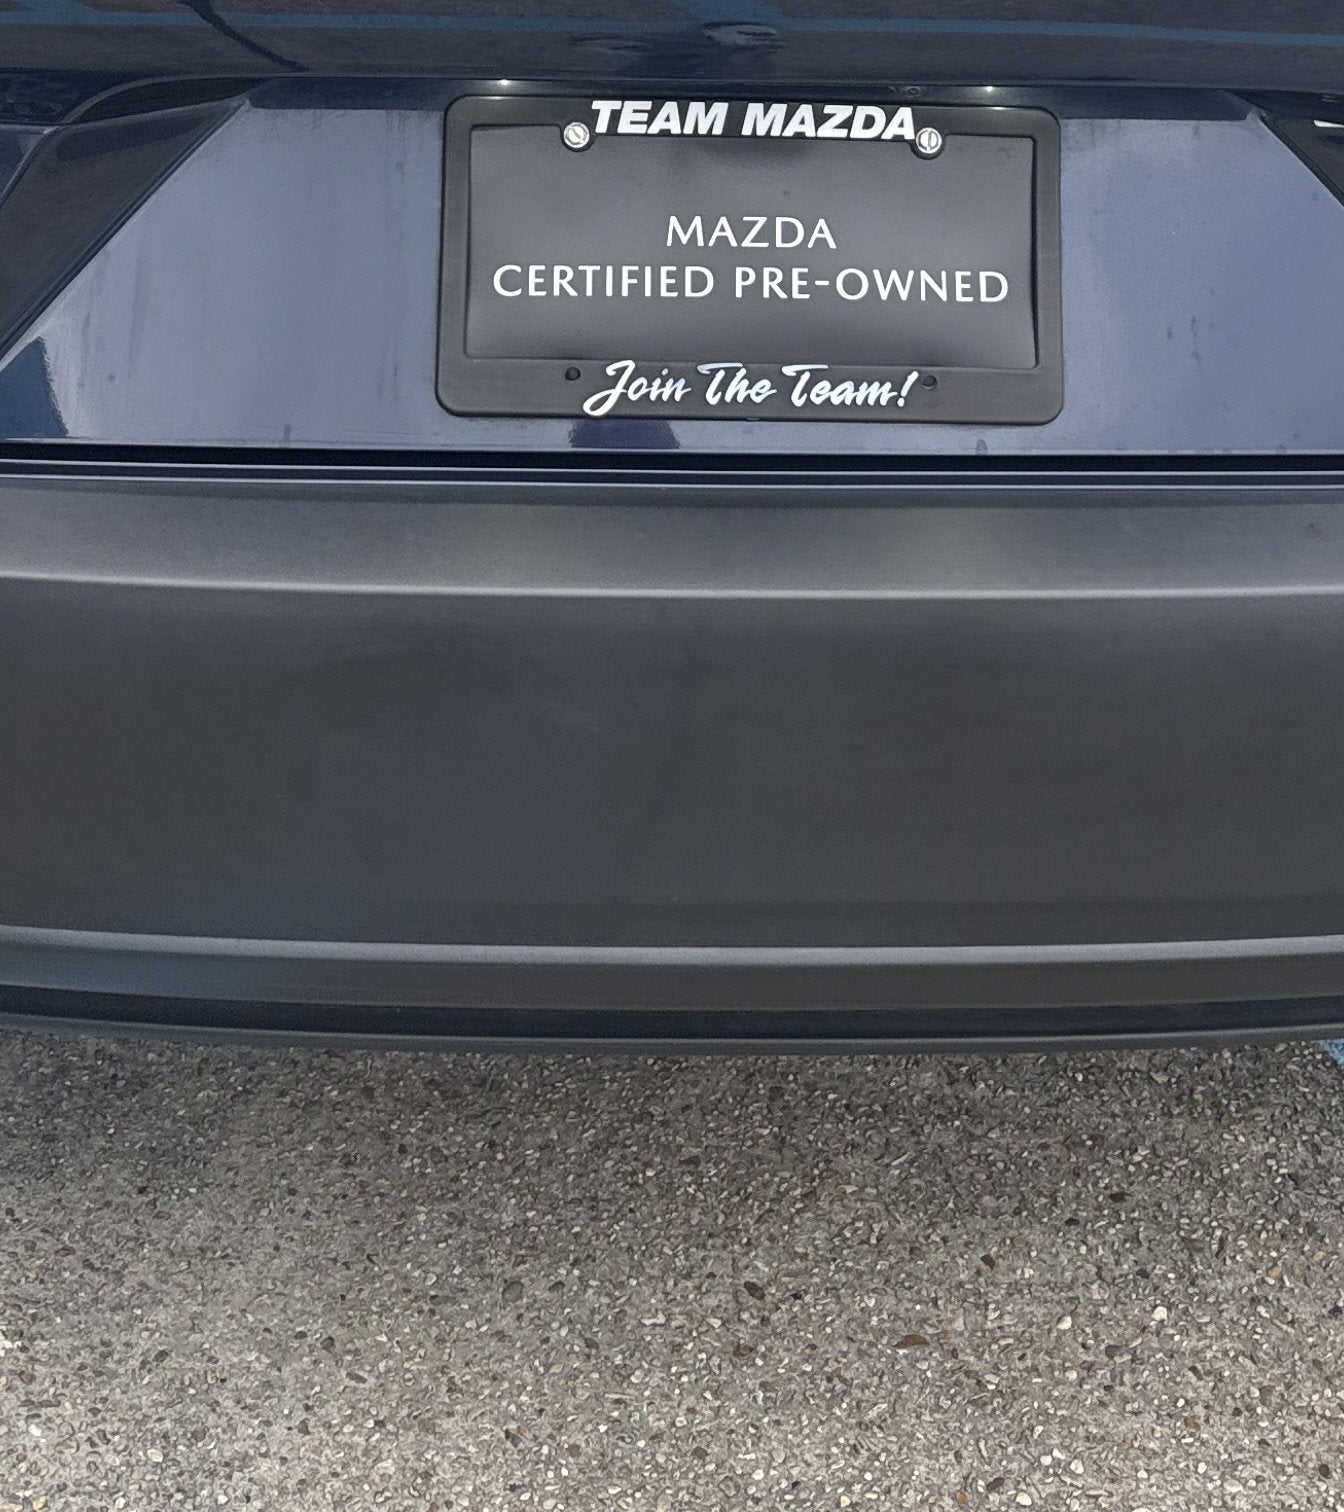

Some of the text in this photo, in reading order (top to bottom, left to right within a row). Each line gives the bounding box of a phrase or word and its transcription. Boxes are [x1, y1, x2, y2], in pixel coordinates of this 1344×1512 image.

[591, 100, 916, 140] TEAM MAZDA
[666, 215, 838, 250] MAZDA
[492, 264, 1010, 303] CERTIFIED PRE-OWNED
[582, 359, 920, 417] Join The Team!
